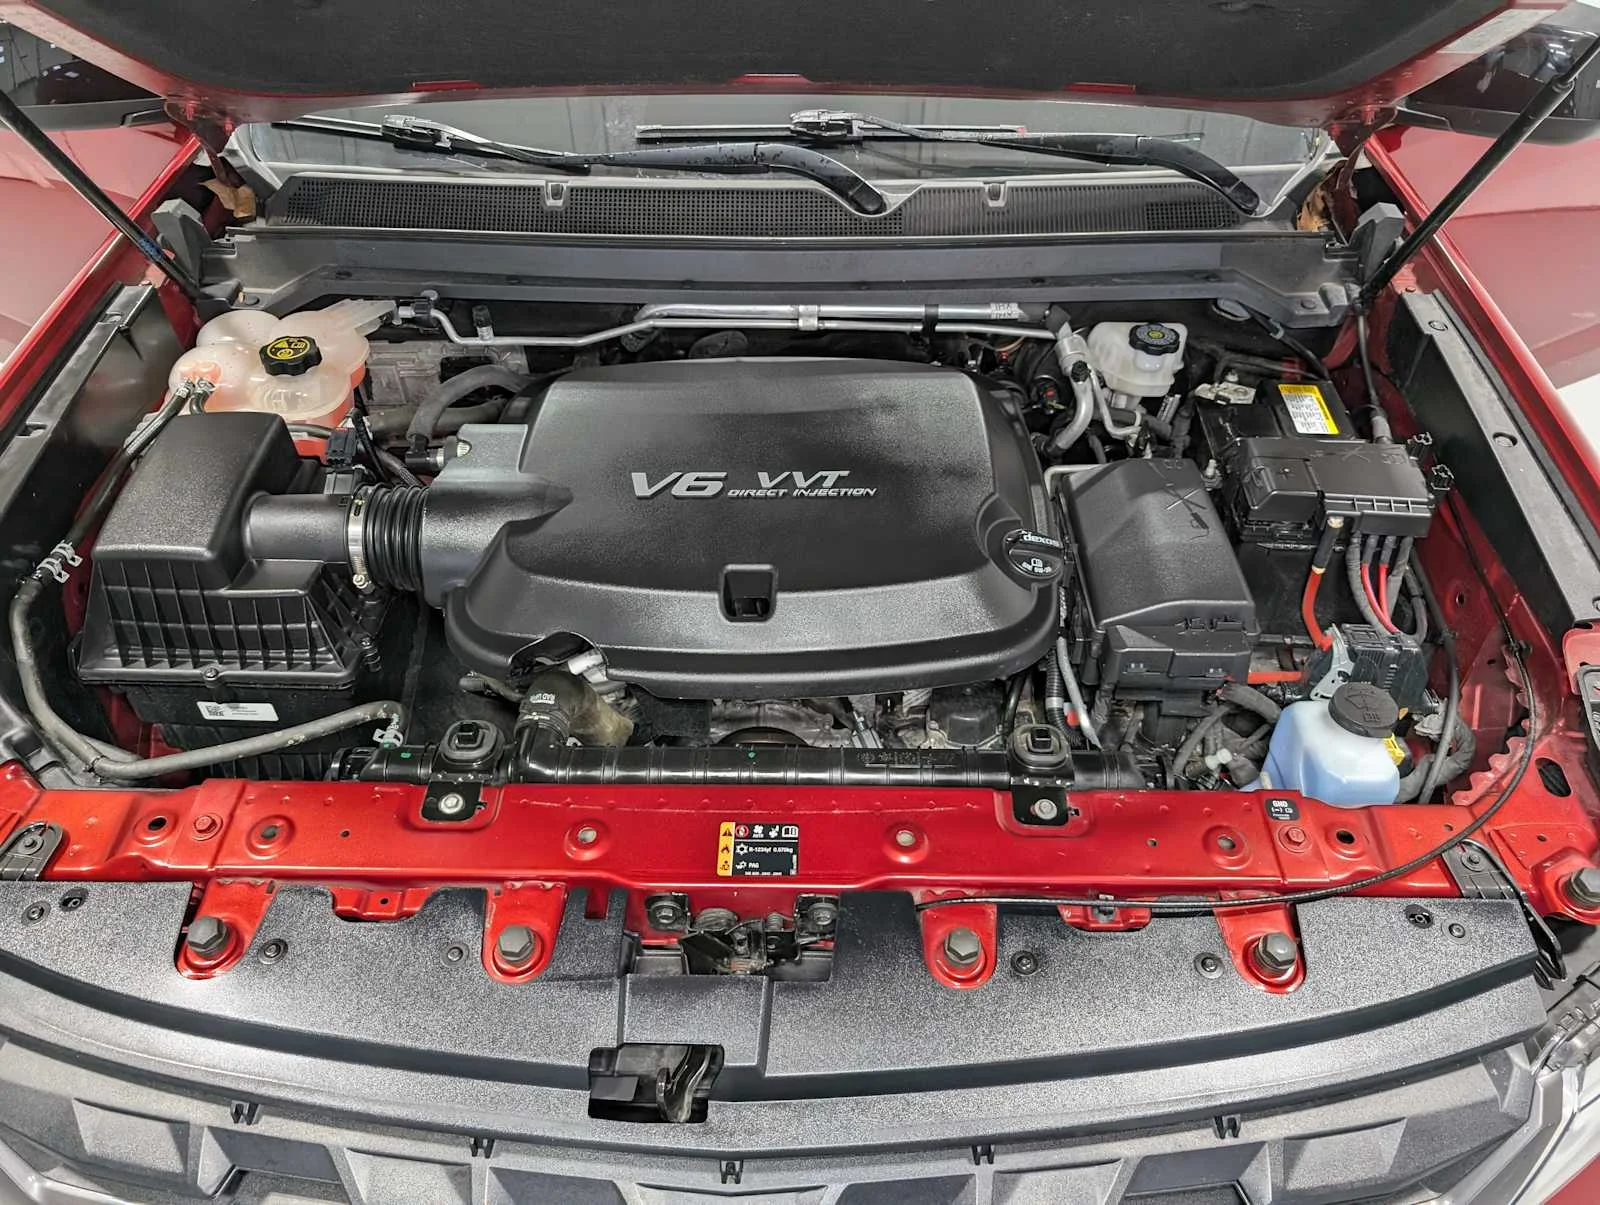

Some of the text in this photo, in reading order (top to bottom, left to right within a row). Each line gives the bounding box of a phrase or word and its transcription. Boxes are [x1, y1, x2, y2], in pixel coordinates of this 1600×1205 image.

[631, 470, 850, 498] V6 VVT
[728, 487, 878, 497] DIRECT INJECTION
[1023, 531, 1060, 548] dexos
